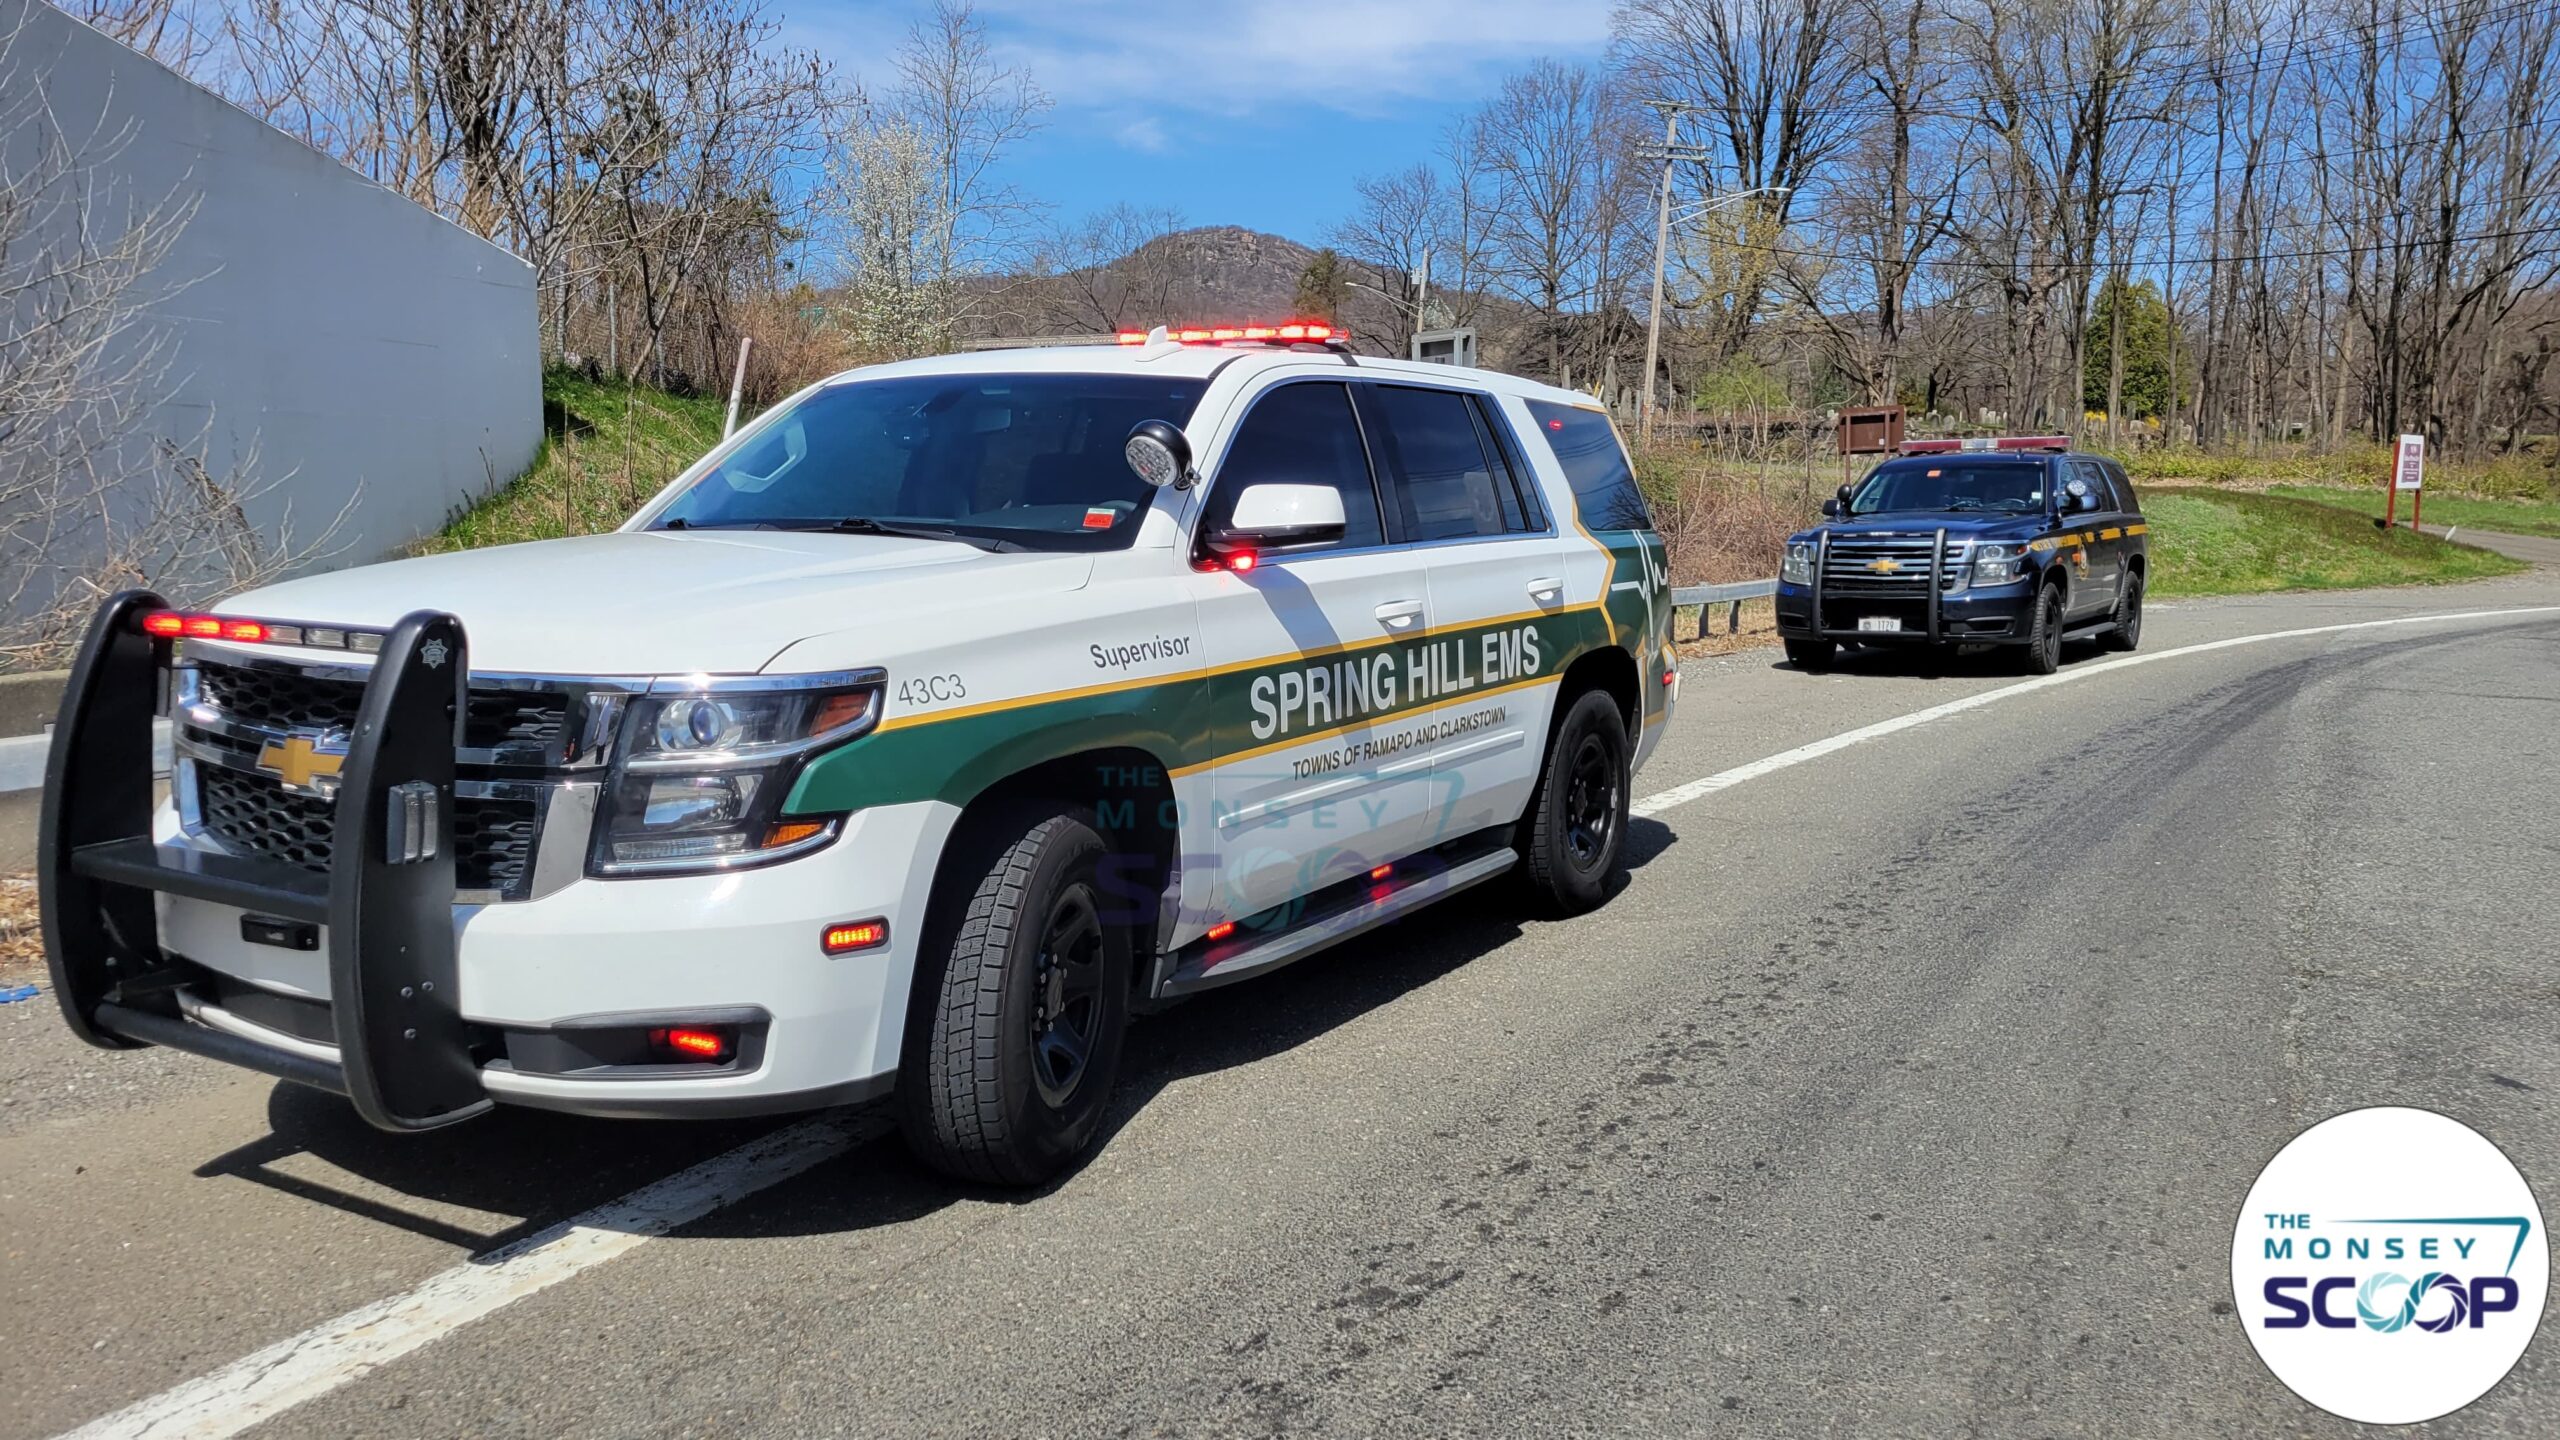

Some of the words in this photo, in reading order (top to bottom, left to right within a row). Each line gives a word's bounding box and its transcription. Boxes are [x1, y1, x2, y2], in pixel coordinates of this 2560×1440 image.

[1090, 635, 1190, 671] Supervisor
[898, 674, 966, 706] 43C3
[1250, 652, 1396, 740] SPRING
[1407, 639, 1475, 702] HILL
[1482, 625, 1540, 685] EMS
[1293, 751, 1340, 781] TOWNS
[1344, 745, 1361, 766] OF
[1363, 731, 1412, 760] RAMAPO
[1415, 725, 1438, 746] AND
[1440, 705, 1506, 737] CLARKSTOWN
